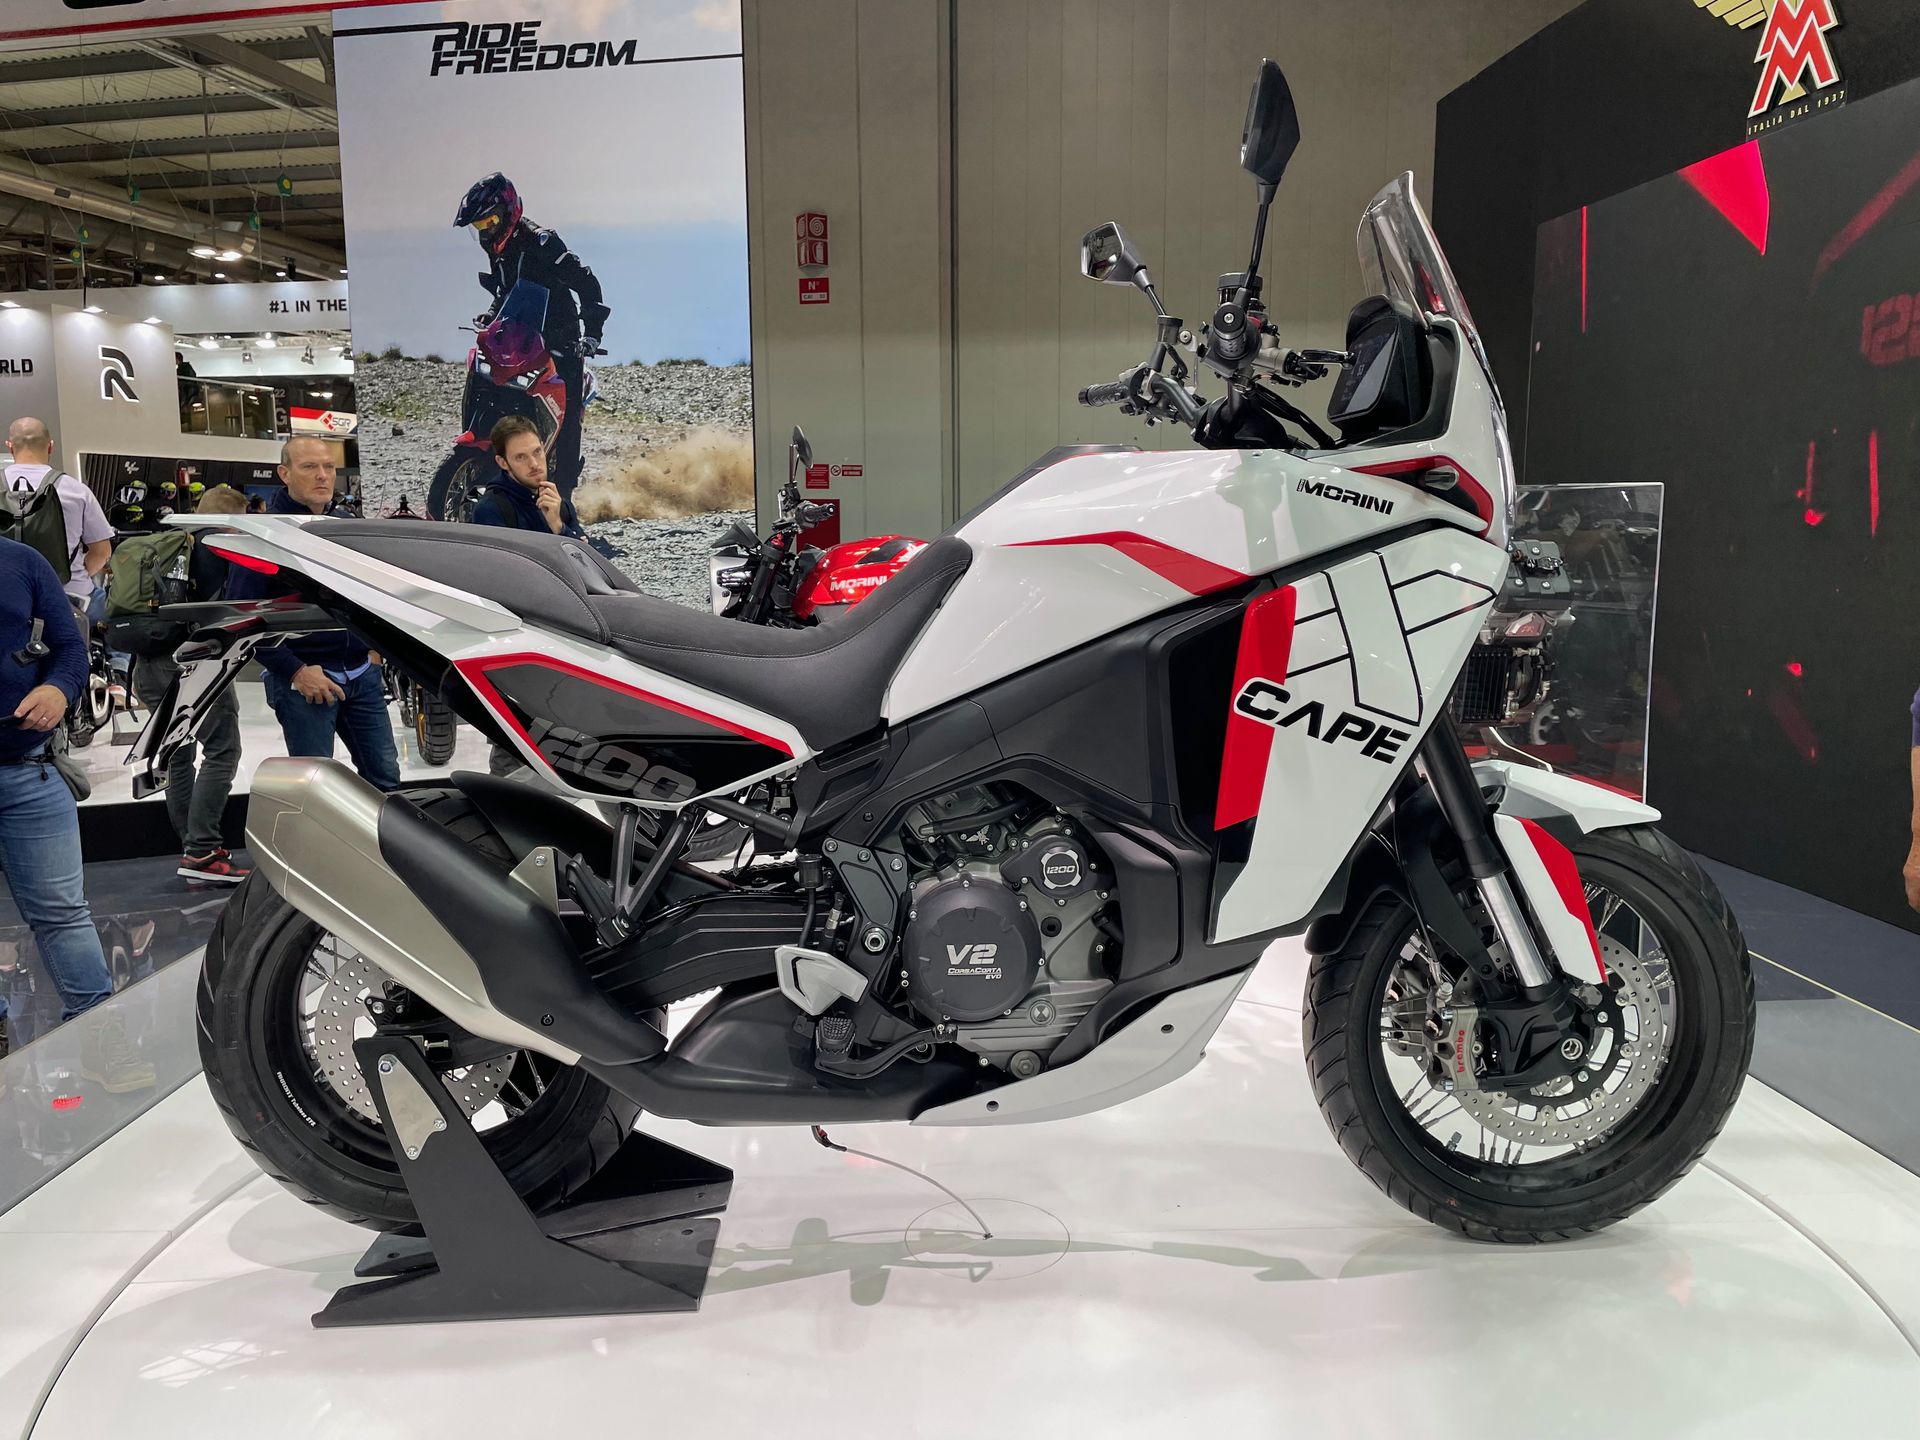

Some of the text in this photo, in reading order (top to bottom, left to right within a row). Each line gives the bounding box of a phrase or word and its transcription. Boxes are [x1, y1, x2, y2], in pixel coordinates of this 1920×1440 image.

[432, 21, 541, 51] RIDE
[430, 40, 638, 76] FREEDOM
[1748, 90, 1846, 135] ITALIA DAL 1937
[269, 299, 347, 313] #1 IN THE
[1861, 291, 1920, 366] 12
[333, 417, 352, 427] SGR
[253, 469, 273, 478] HJC
[1301, 479, 1395, 515] MORINI
[830, 575, 888, 591] MORINI
[1236, 680, 1412, 765] CAPE
[528, 716, 697, 800] 1200
[1046, 865, 1076, 874] 1200
[946, 943, 998, 965] V2
[1457, 1030, 1466, 1072] brembo
